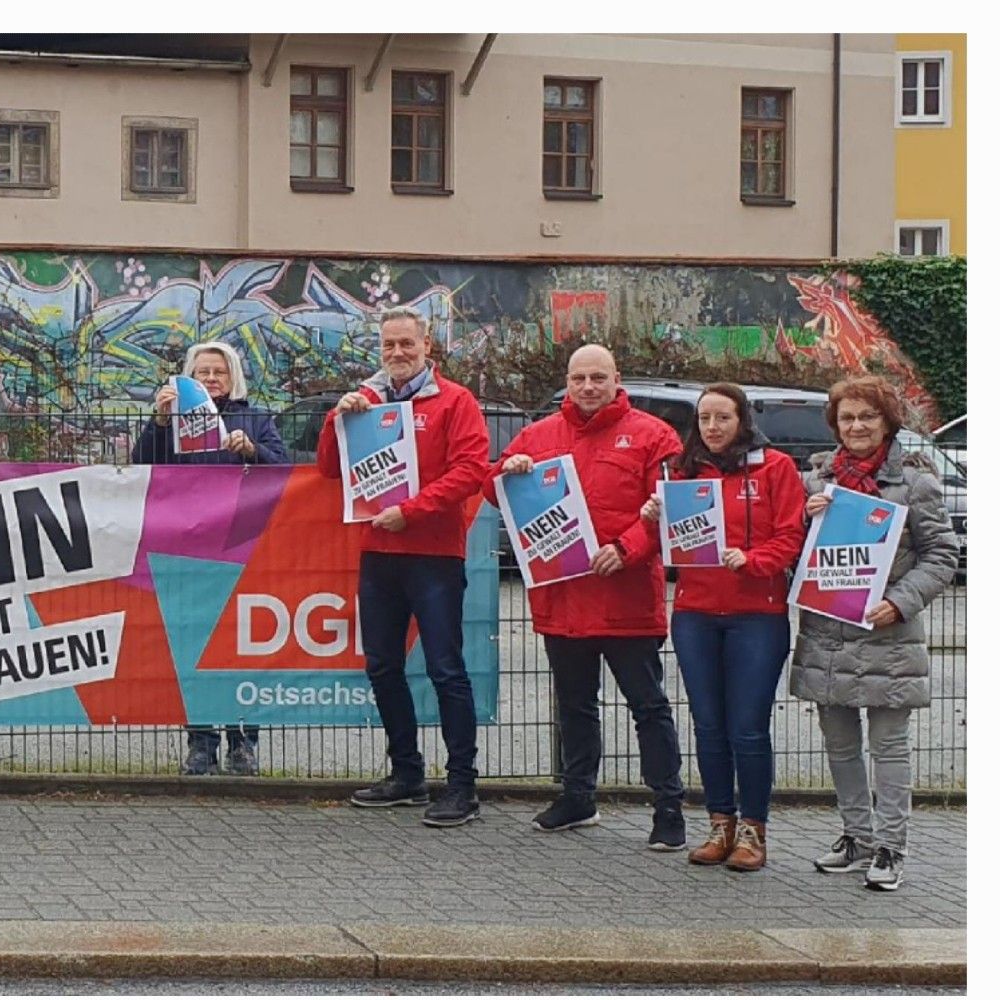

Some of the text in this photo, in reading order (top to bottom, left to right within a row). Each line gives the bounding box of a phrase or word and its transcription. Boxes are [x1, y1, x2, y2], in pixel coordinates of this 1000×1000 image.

[354, 447, 398, 482] NEIN
[524, 505, 569, 544] NEIN
[673, 513, 710, 537] NEIN
[820, 546, 870, 567] NEIN
[236, 592, 365, 657] DG
